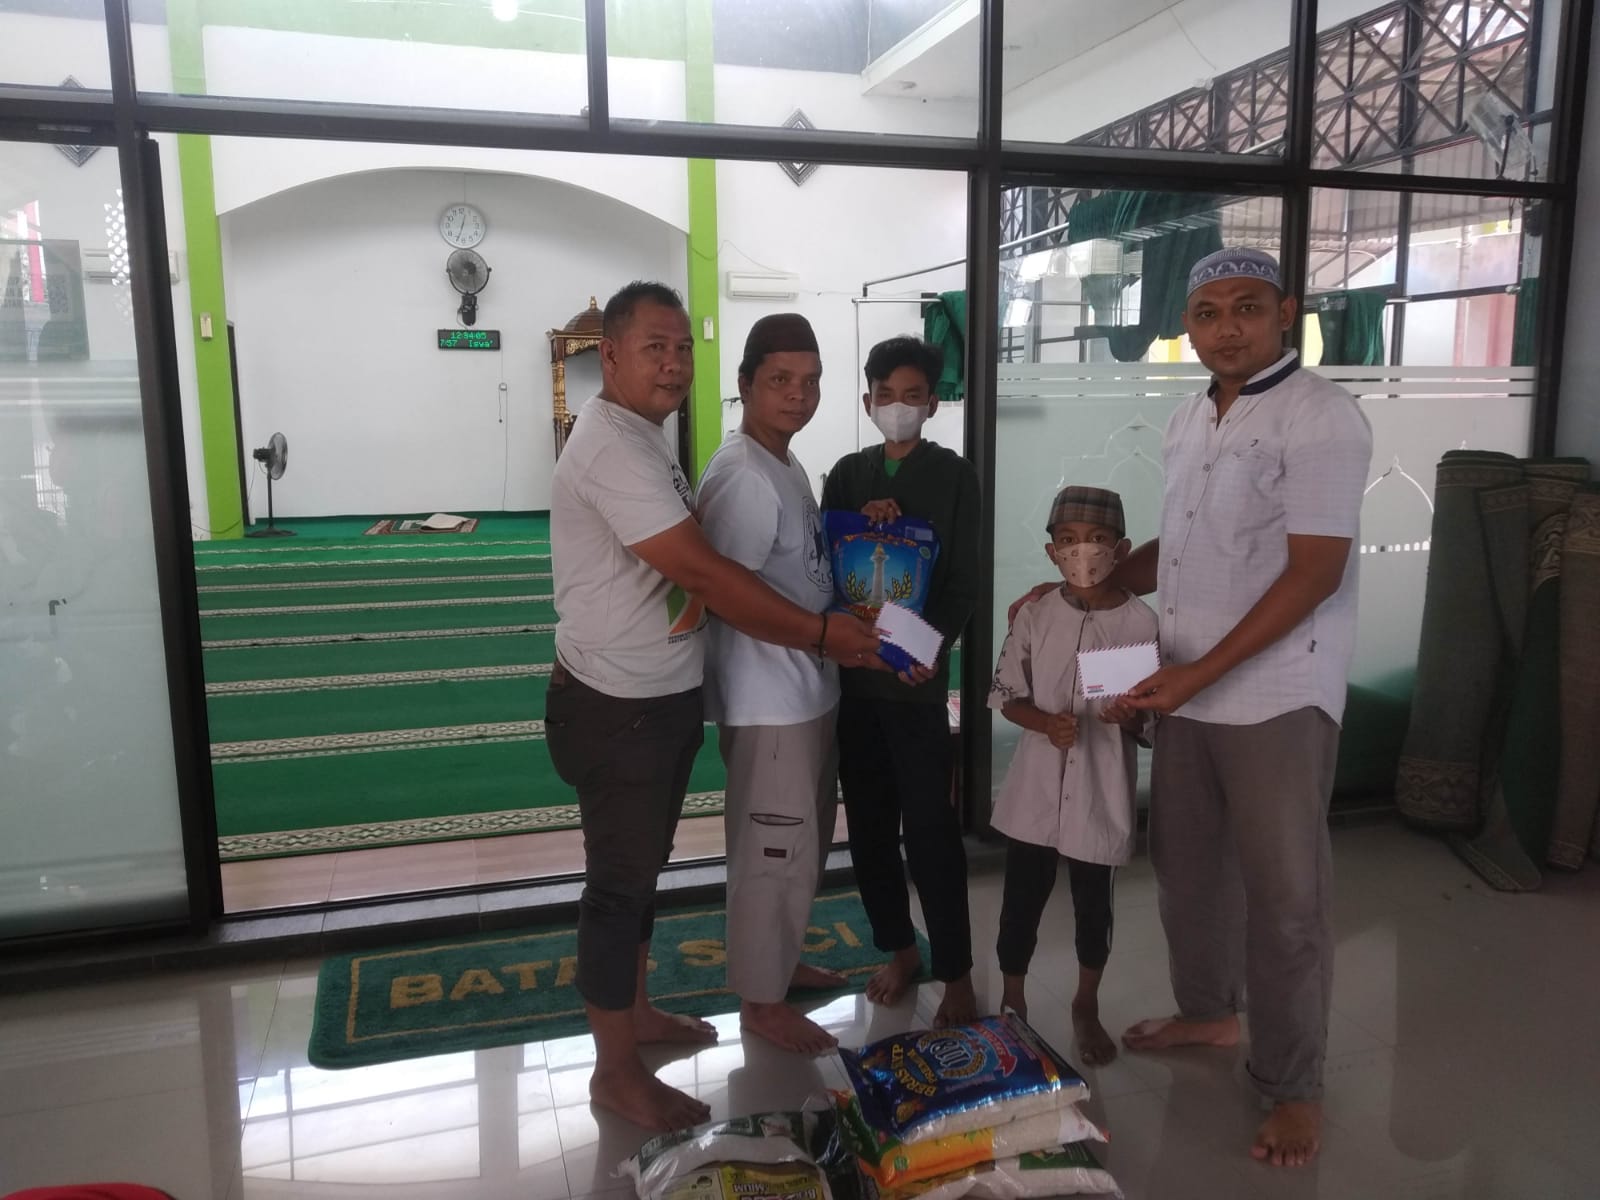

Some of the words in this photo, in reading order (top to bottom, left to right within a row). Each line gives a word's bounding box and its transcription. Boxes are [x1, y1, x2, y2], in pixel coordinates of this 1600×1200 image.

[390, 952, 657, 1008] BAT
[677, 921, 864, 967] SCI
[894, 1067, 937, 1097] BERAS
